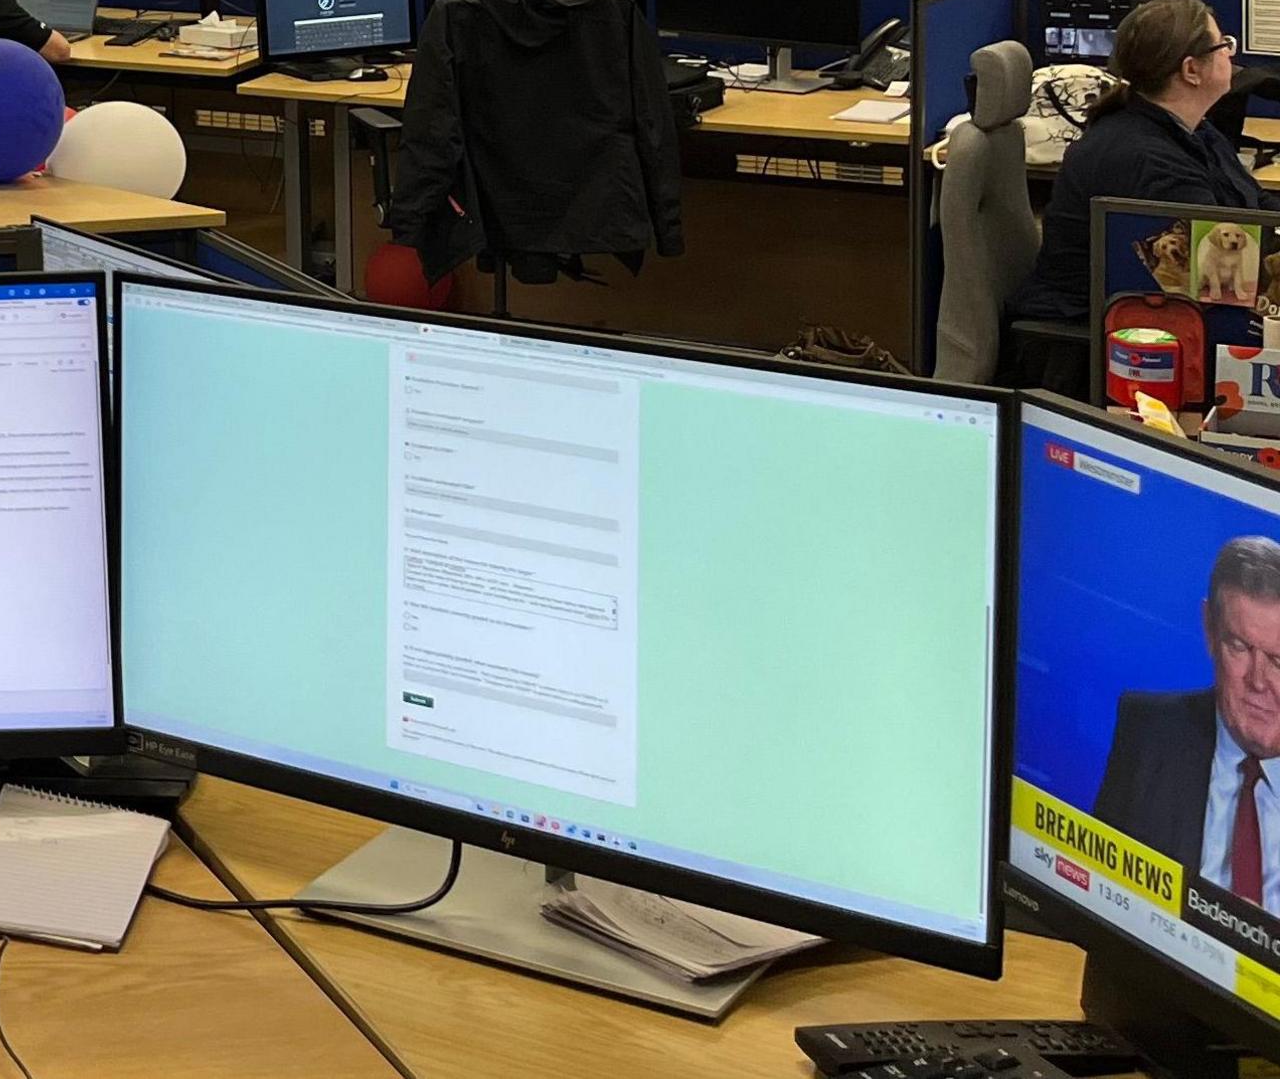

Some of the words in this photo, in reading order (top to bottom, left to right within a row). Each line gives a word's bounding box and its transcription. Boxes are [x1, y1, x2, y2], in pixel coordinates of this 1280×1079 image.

[1049, 447, 1070, 464] LIVE
[1035, 801, 1118, 871] BREAKING
[1123, 850, 1174, 901] NEWS
[1002, 880, 1040, 912] Lenovo
[1034, 847, 1054, 869] sky
[1057, 861, 1089, 886] news
[1098, 883, 1131, 911] 13:05
[1150, 912, 1177, 938] FTSE
[1188, 887, 1270, 952] Badenoch
